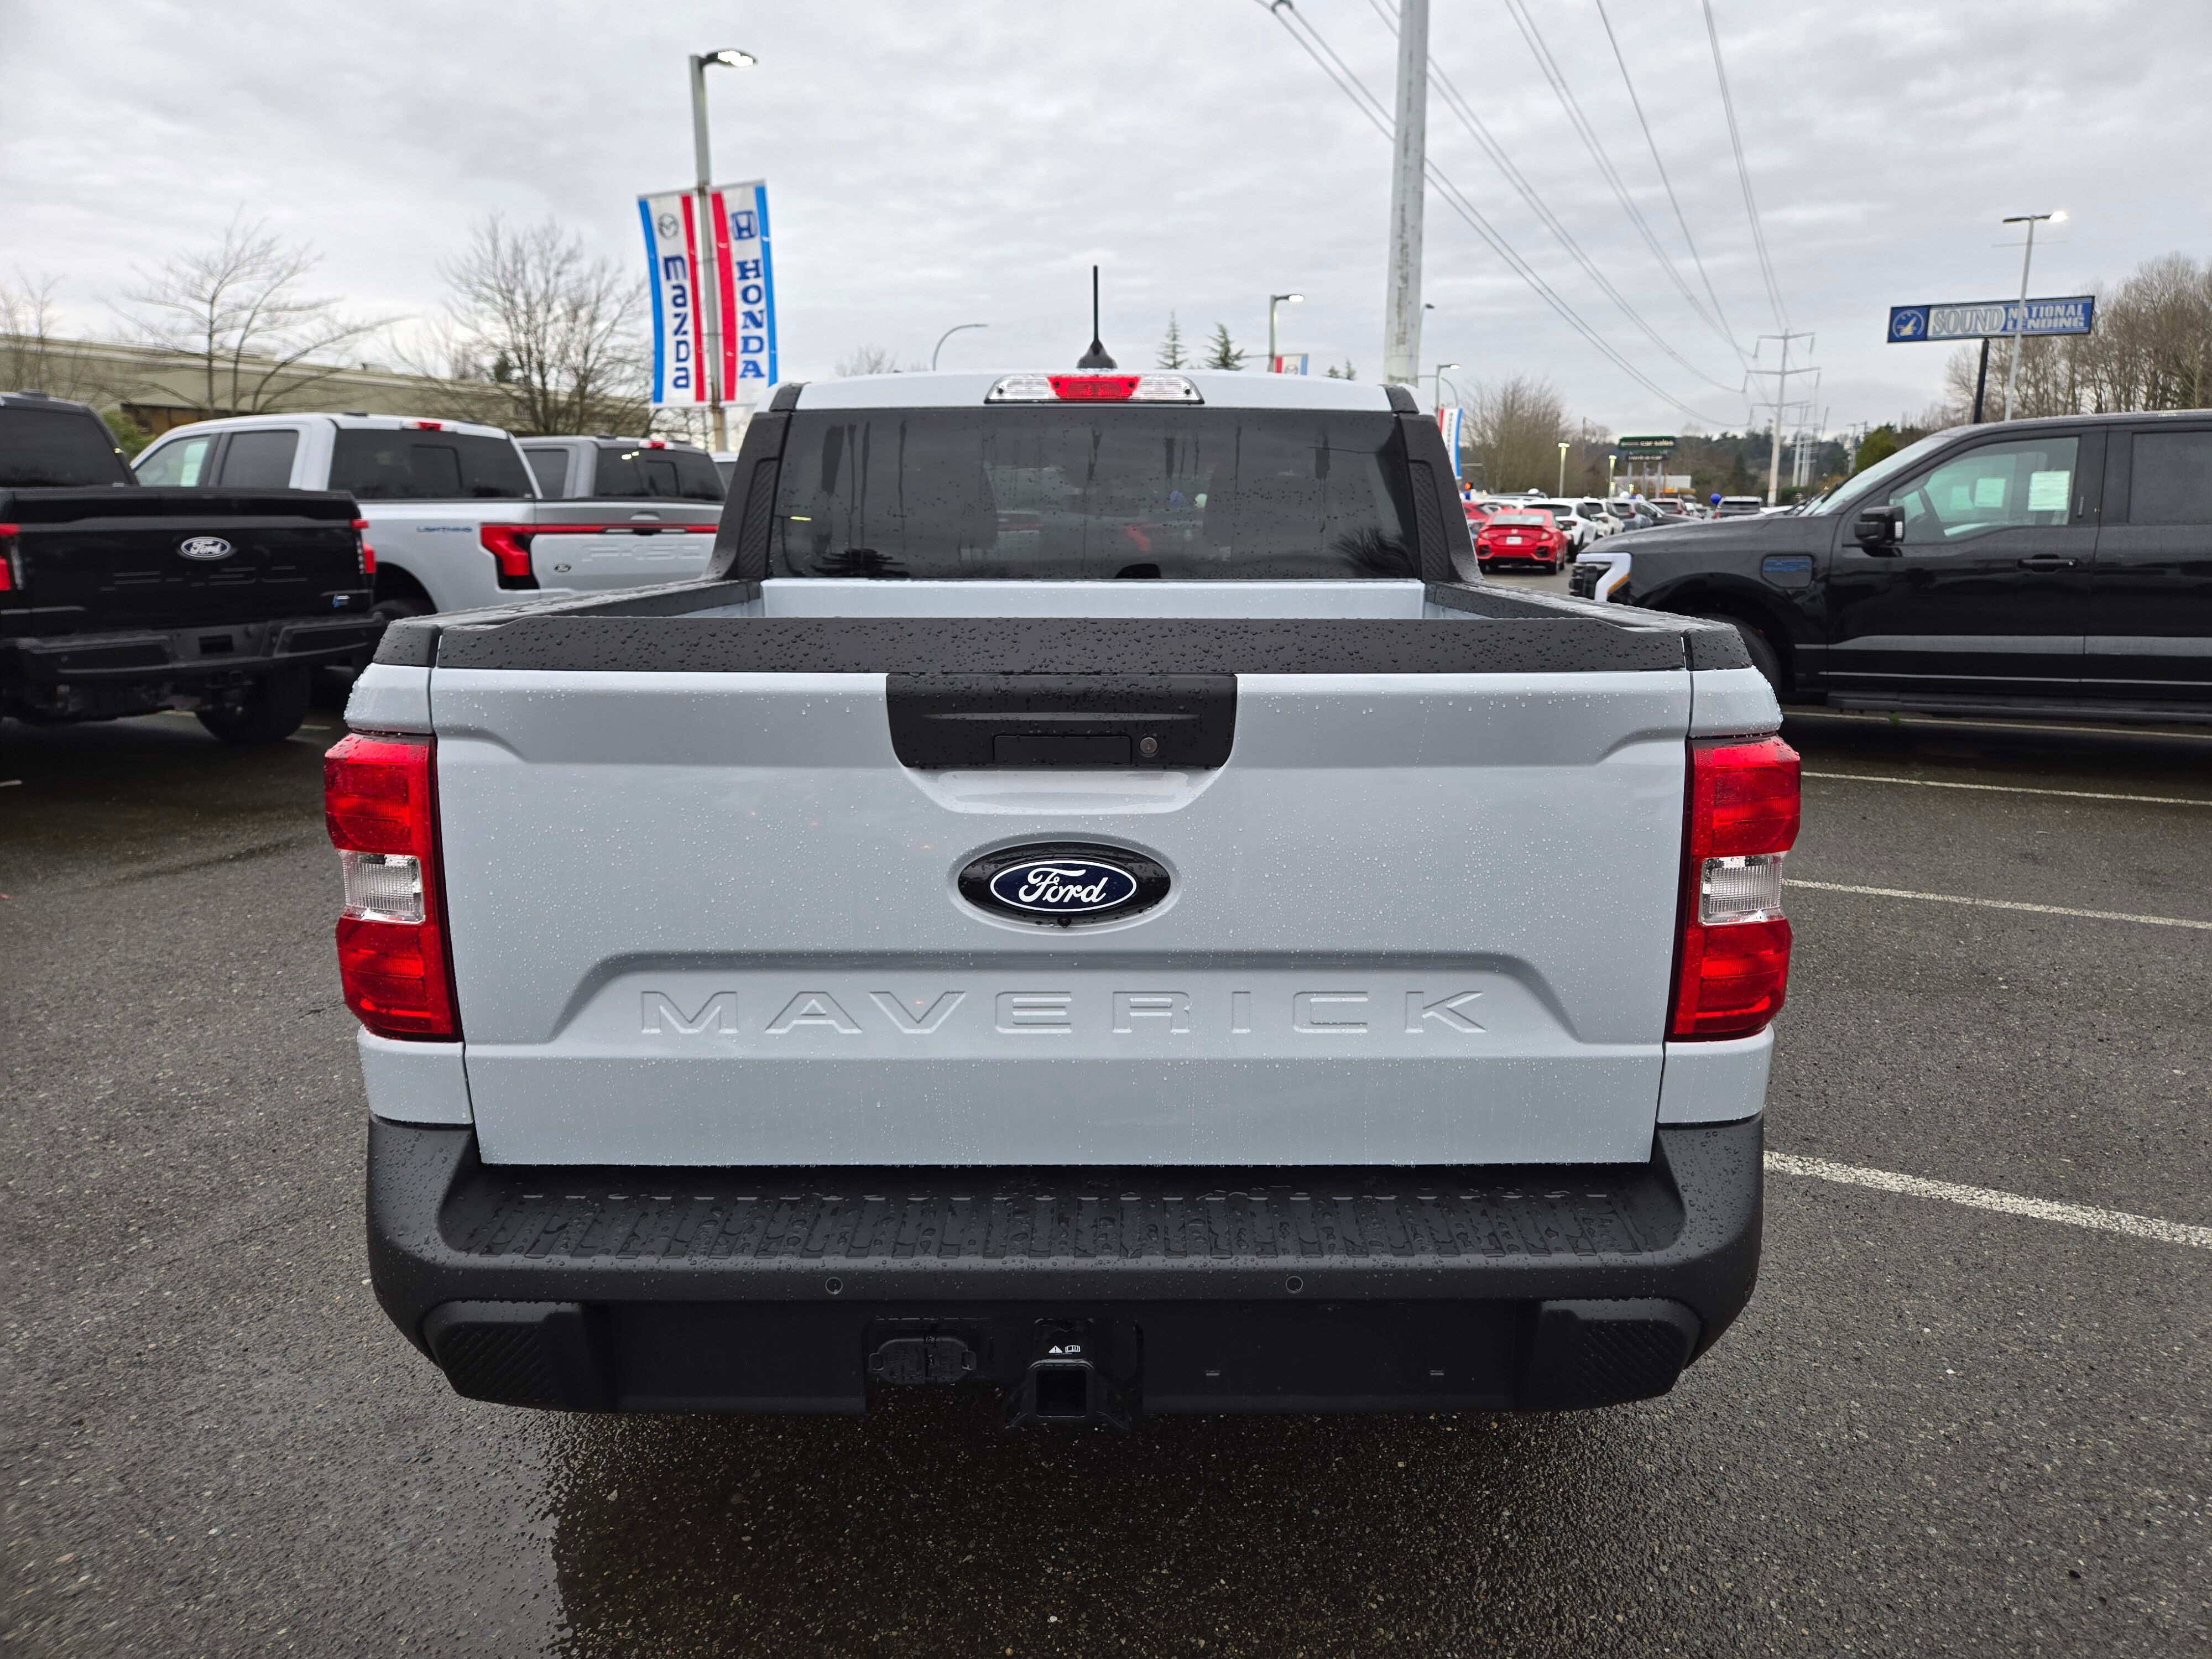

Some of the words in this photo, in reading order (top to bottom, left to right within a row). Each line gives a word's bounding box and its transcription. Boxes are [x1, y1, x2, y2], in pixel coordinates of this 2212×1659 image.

[735, 259, 765, 379] HONDA
[1933, 309, 2005, 333] SOUND
[190, 539, 221, 555] Ford
[1018, 867, 1107, 904] Ford
[641, 990, 1488, 1034] MAVERICK
